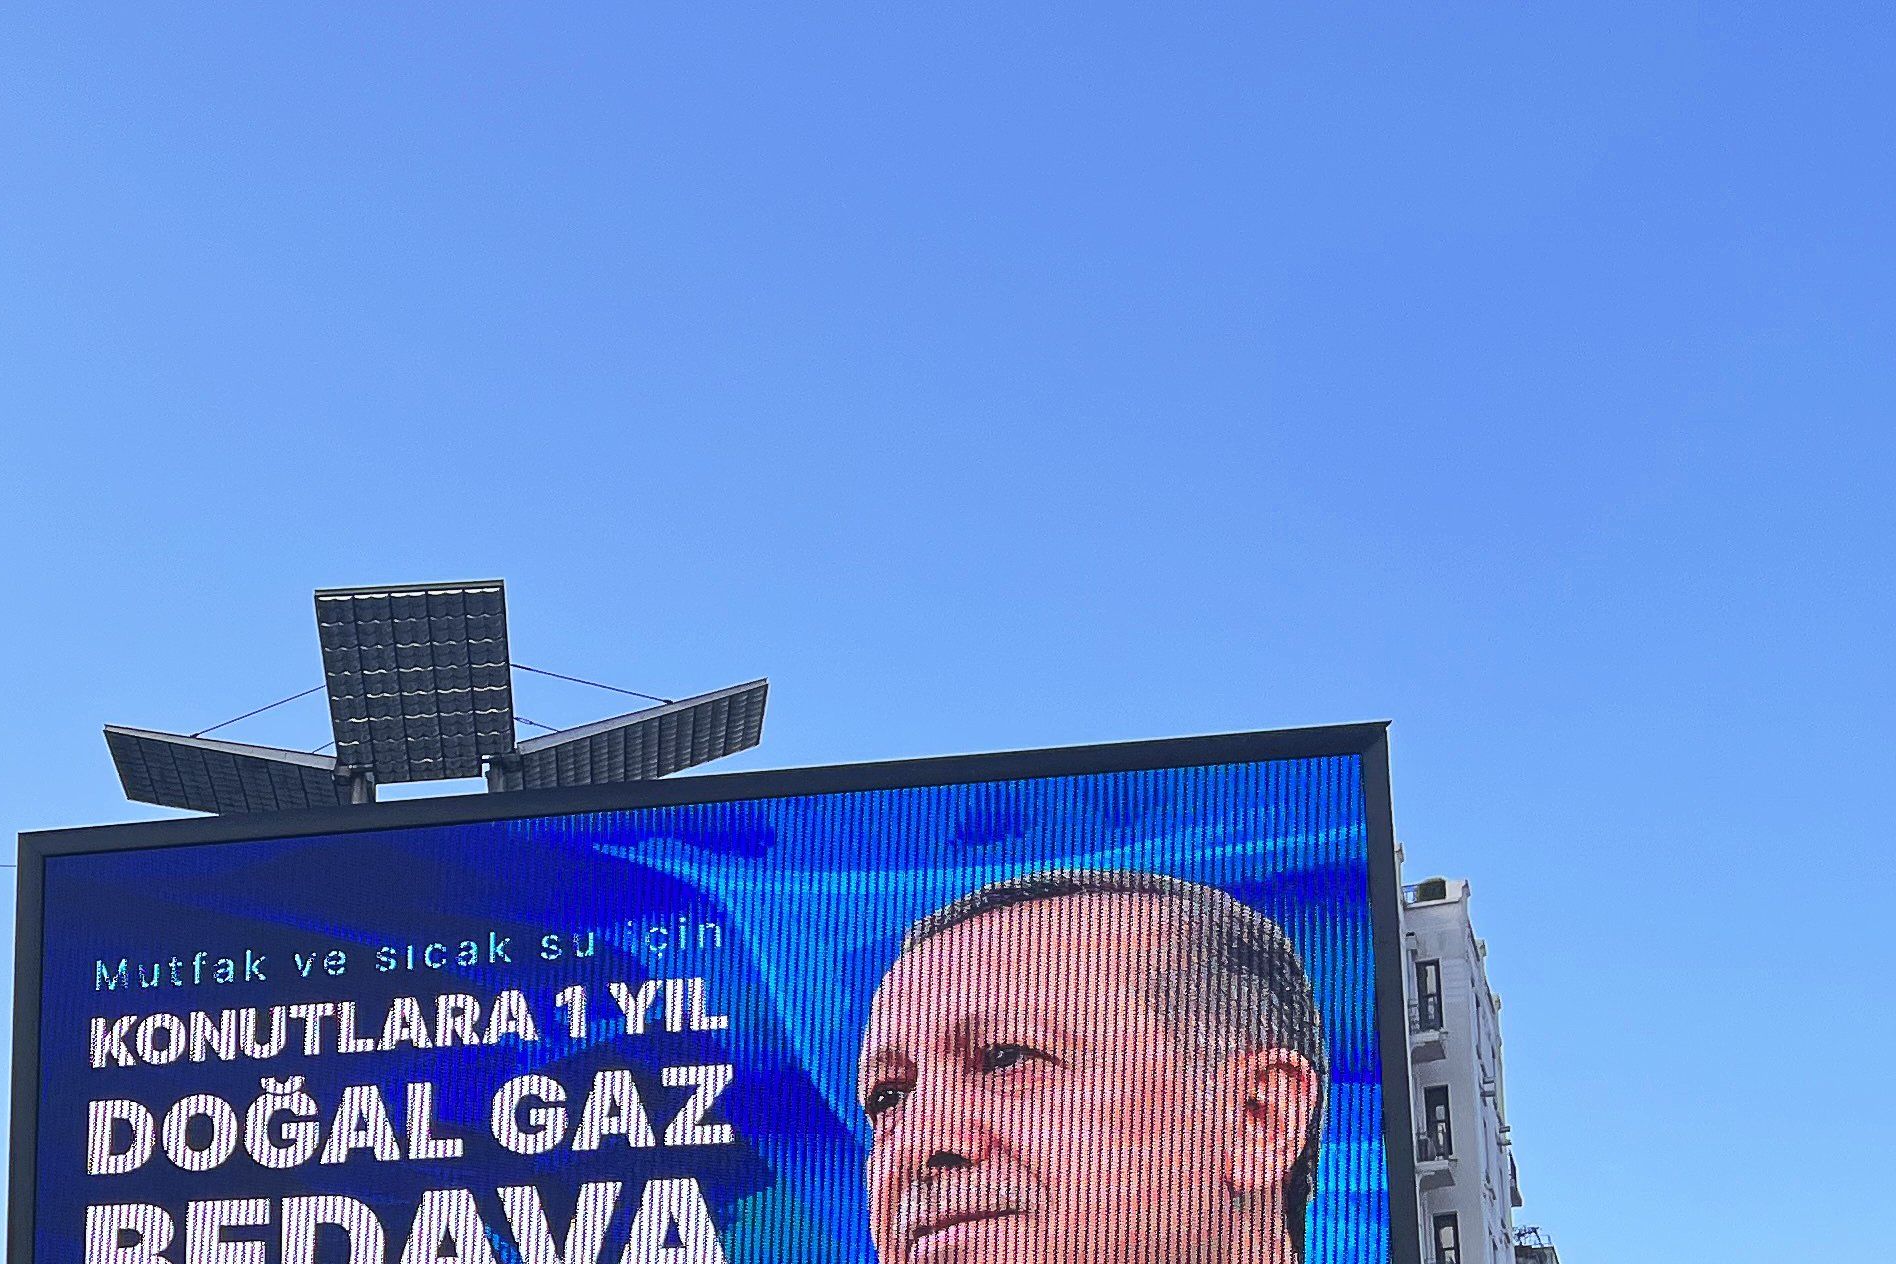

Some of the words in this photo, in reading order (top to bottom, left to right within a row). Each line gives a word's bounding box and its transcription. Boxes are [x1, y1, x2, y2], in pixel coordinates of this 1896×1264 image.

[95, 949, 268, 991] Mutfak
[292, 950, 348, 979] ve
[538, 927, 597, 960] su
[88, 989, 541, 1069] KONUTLARA
[554, 984, 588, 1039] 1
[608, 976, 729, 1035] YIL
[87, 1075, 465, 1176] DOĞAL
[489, 1064, 735, 1156] GAZ
